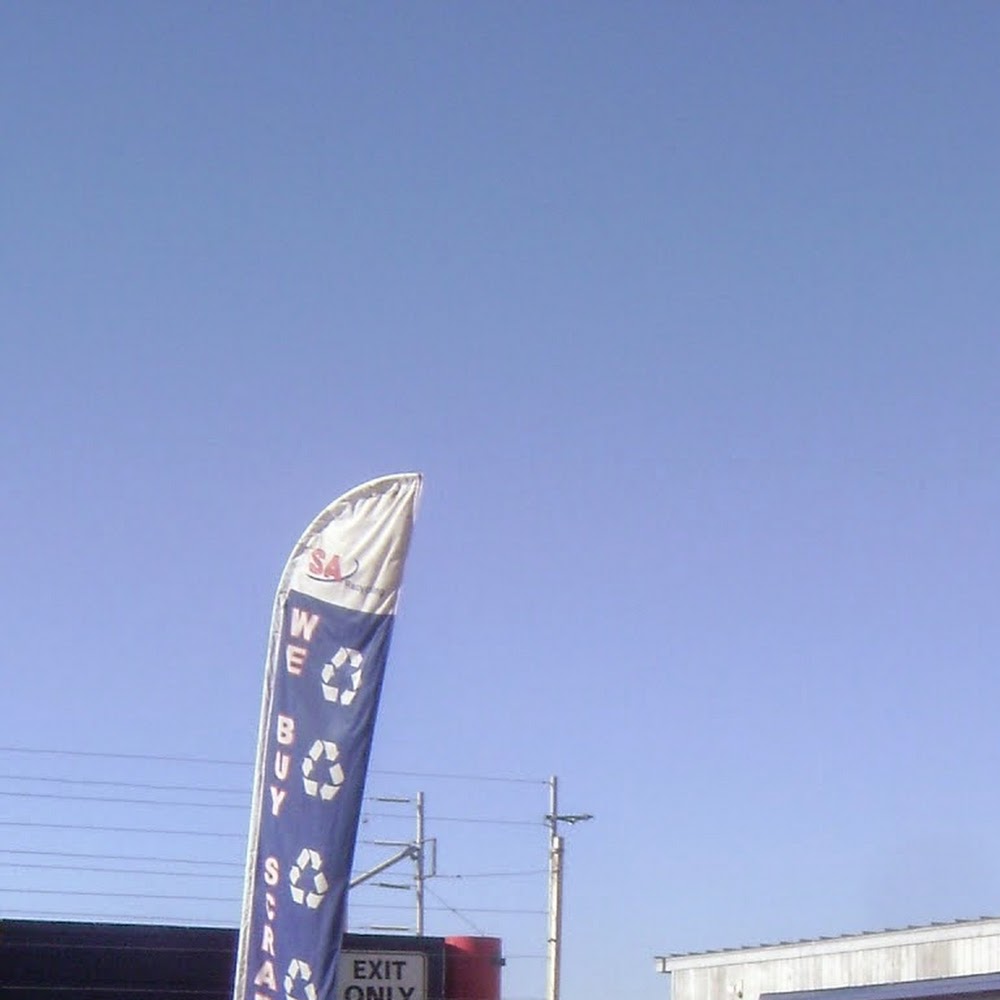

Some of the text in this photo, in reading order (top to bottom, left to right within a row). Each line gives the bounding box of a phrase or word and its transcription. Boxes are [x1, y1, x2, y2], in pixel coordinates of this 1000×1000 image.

[308, 548, 342, 582] SA
[286, 608, 320, 675] WE
[269, 714, 295, 817] BUY
[353, 960, 407, 980] EXIT
